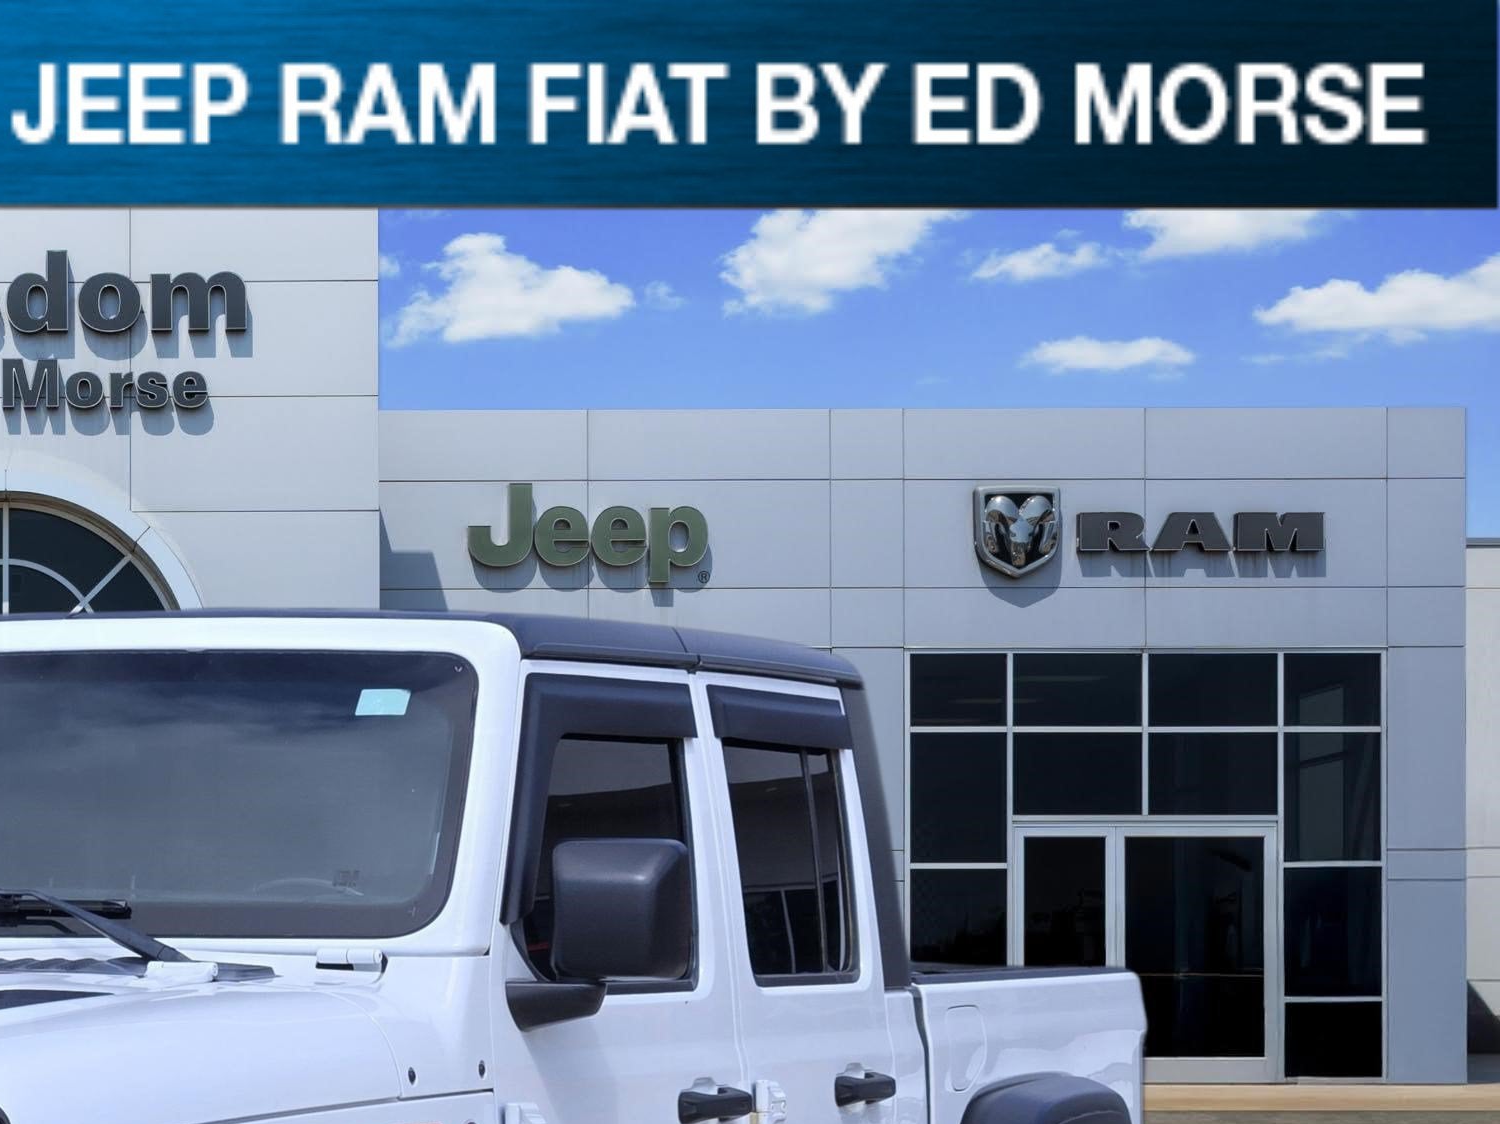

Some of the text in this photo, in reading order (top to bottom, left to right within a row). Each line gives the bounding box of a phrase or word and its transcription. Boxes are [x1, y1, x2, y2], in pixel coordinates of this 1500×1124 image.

[1, 357, 210, 410] Morse
[467, 482, 709, 583] Jeep
[1076, 511, 1326, 552] RAM
